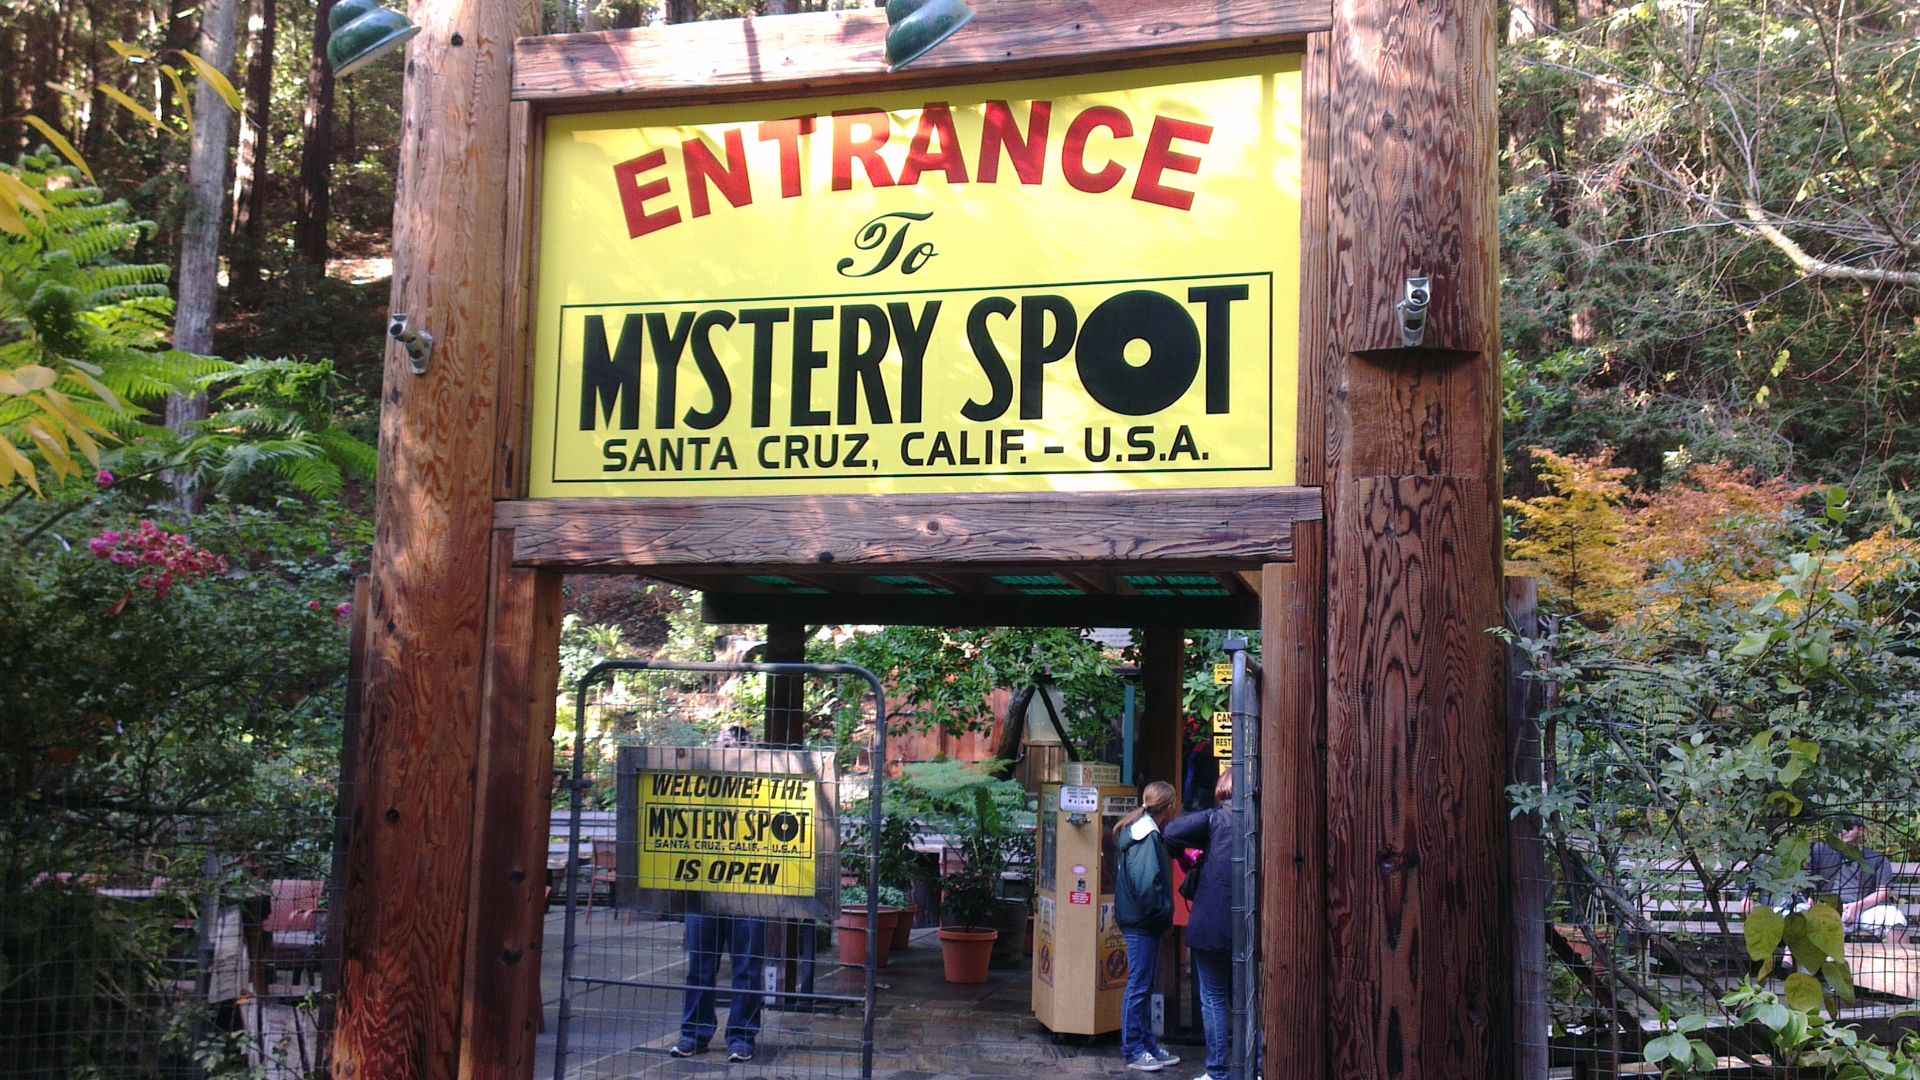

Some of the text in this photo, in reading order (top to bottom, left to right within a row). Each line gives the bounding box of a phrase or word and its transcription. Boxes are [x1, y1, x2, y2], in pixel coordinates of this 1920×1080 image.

[614, 100, 1214, 239] ENTRANCE
[836, 211, 938, 277] To
[579, 283, 1249, 431] MYSTERY SPOT
[602, 424, 1209, 472] SANTA CRUZ, CALIF. - U.S.A.
[652, 774, 808, 800] WELCOME! THE
[649, 807, 809, 843] MYSTERY SPOT
[654, 839, 690, 849] SANTA
[674, 859, 780, 885] IS OPEN
